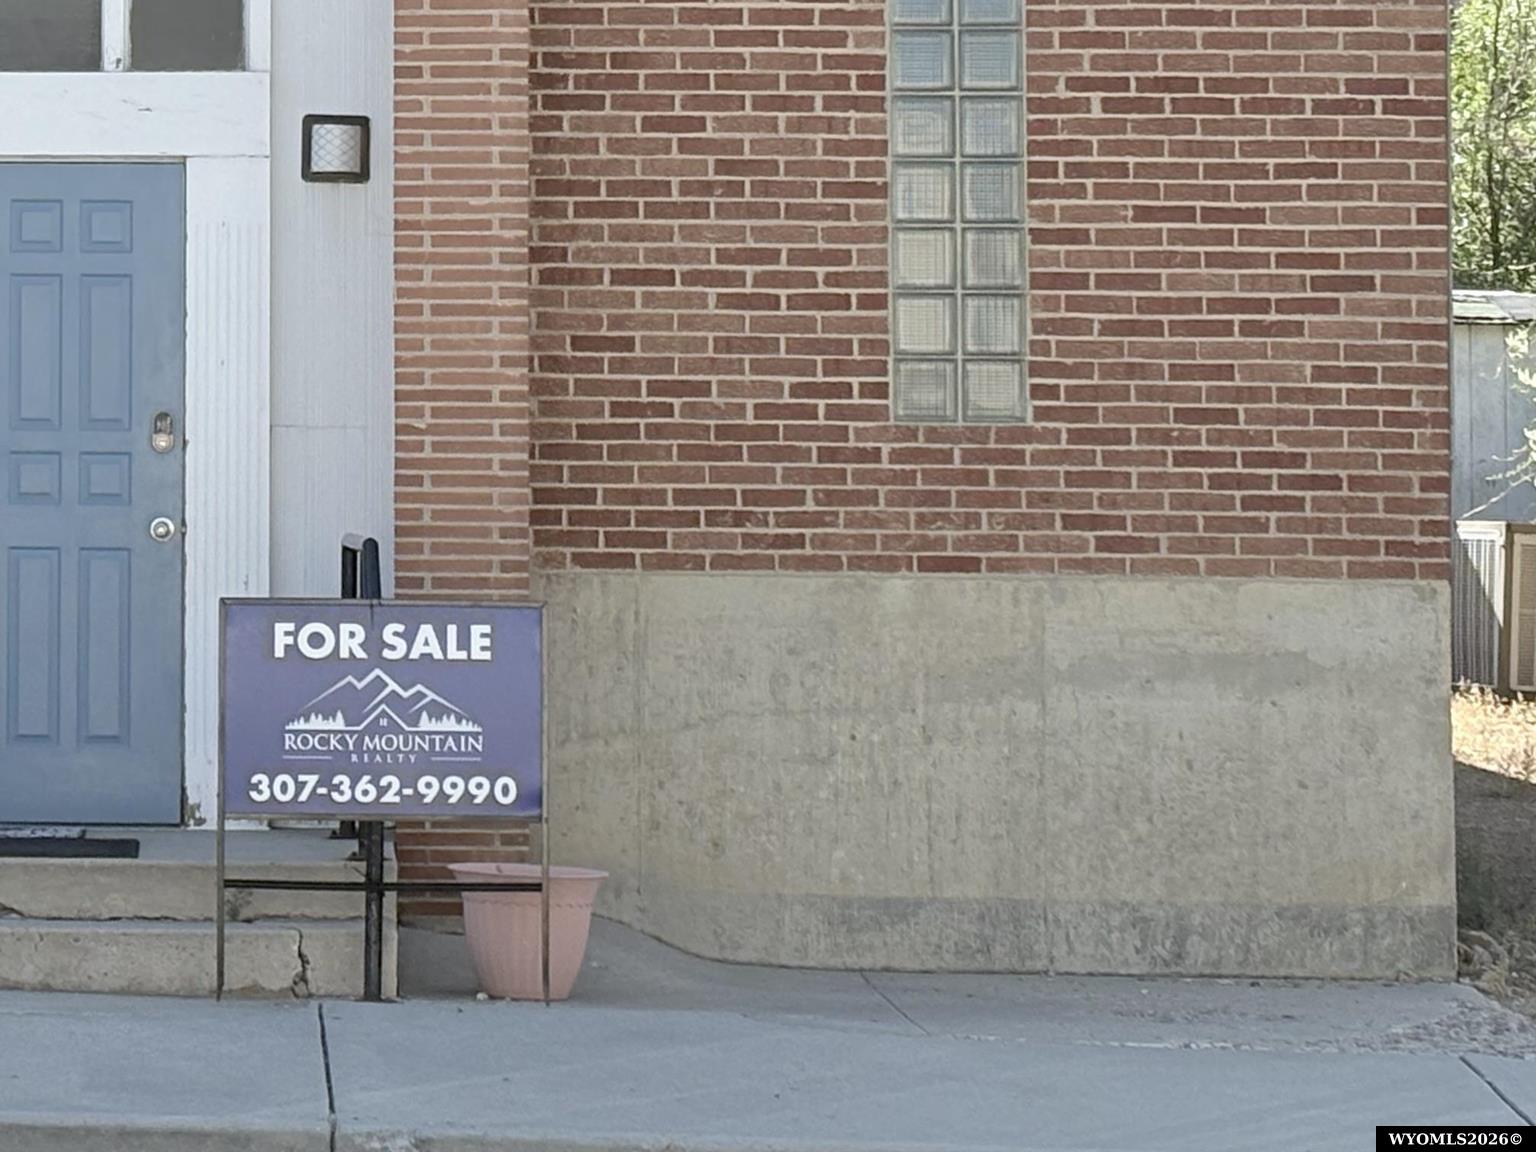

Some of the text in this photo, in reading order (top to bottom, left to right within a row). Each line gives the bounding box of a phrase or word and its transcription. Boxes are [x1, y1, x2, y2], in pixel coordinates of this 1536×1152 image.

[273, 622, 492, 661] FOR SALE
[284, 733, 483, 753] ROCKY MOUNTAIN
[351, 753, 418, 764] REALTY
[248, 774, 517, 805] 307-362-9990
